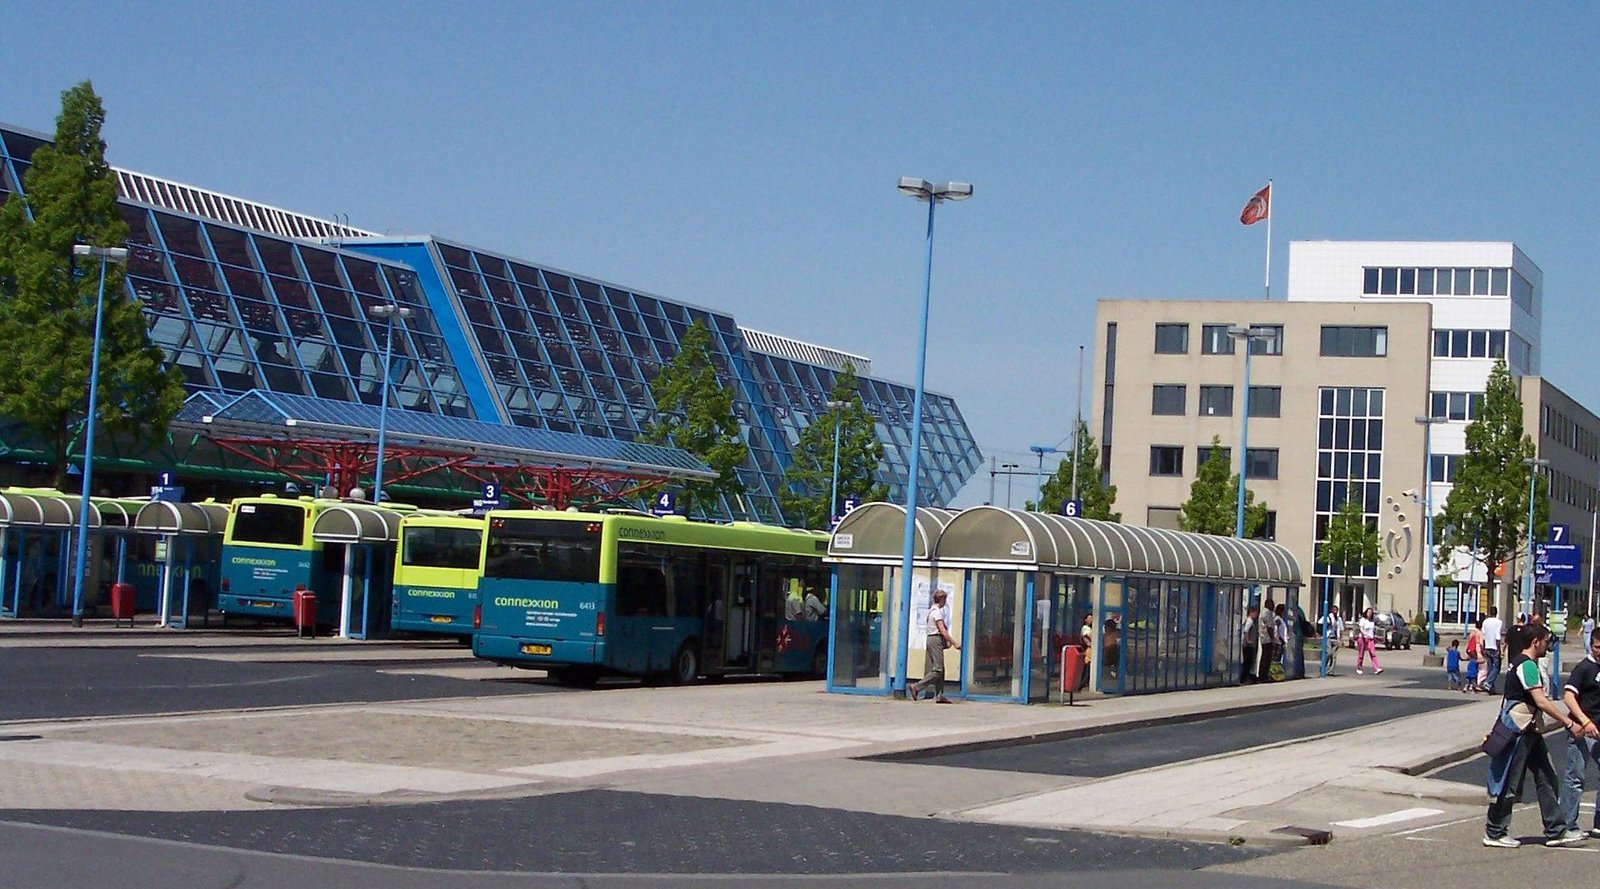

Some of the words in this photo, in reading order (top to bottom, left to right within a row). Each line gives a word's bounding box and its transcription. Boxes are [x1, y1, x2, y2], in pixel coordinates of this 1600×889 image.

[162, 473, 169, 485] 1
[486, 485, 495, 498] 3
[660, 493, 669, 507] 4
[845, 500, 854, 513] 5
[1066, 502, 1076, 516] 6
[1553, 527, 1563, 541] 7
[232, 556, 276, 567] connexxion
[407, 588, 456, 599] connexxion
[494, 596, 559, 609] connexxion
